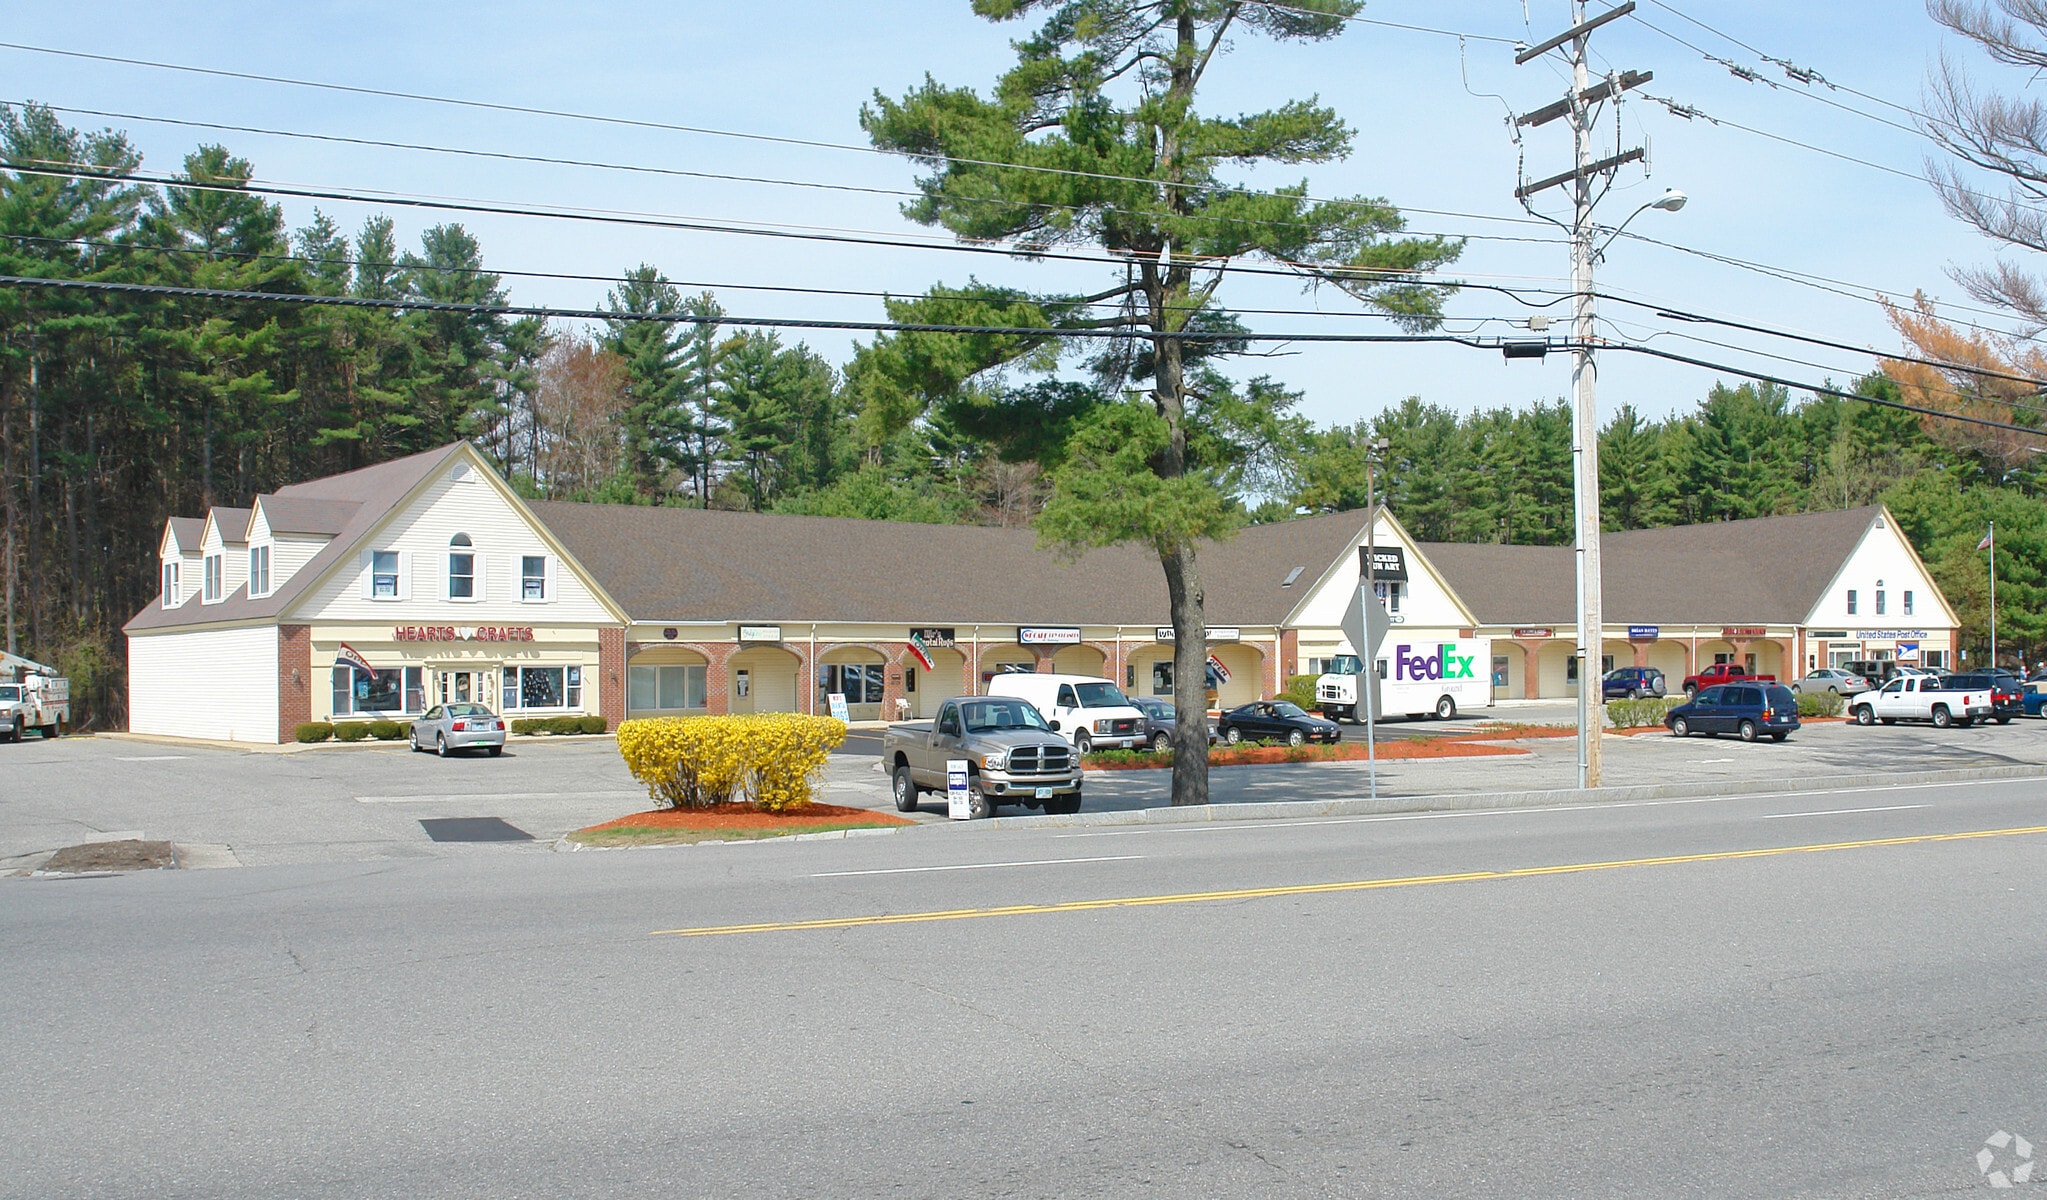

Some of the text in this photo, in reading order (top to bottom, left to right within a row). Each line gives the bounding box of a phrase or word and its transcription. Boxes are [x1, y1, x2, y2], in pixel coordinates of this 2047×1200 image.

[1367, 562, 1400, 571] UN ART
[394, 626, 534, 641] HEARTS CRAFTS
[1856, 630, 1876, 639] United
[1877, 630, 1896, 639] States
[1897, 630, 1910, 639] Post
[1911, 629, 1928, 639] Office
[1209, 658, 1228, 677] OPEN
[1396, 644, 1475, 681] FedEx
